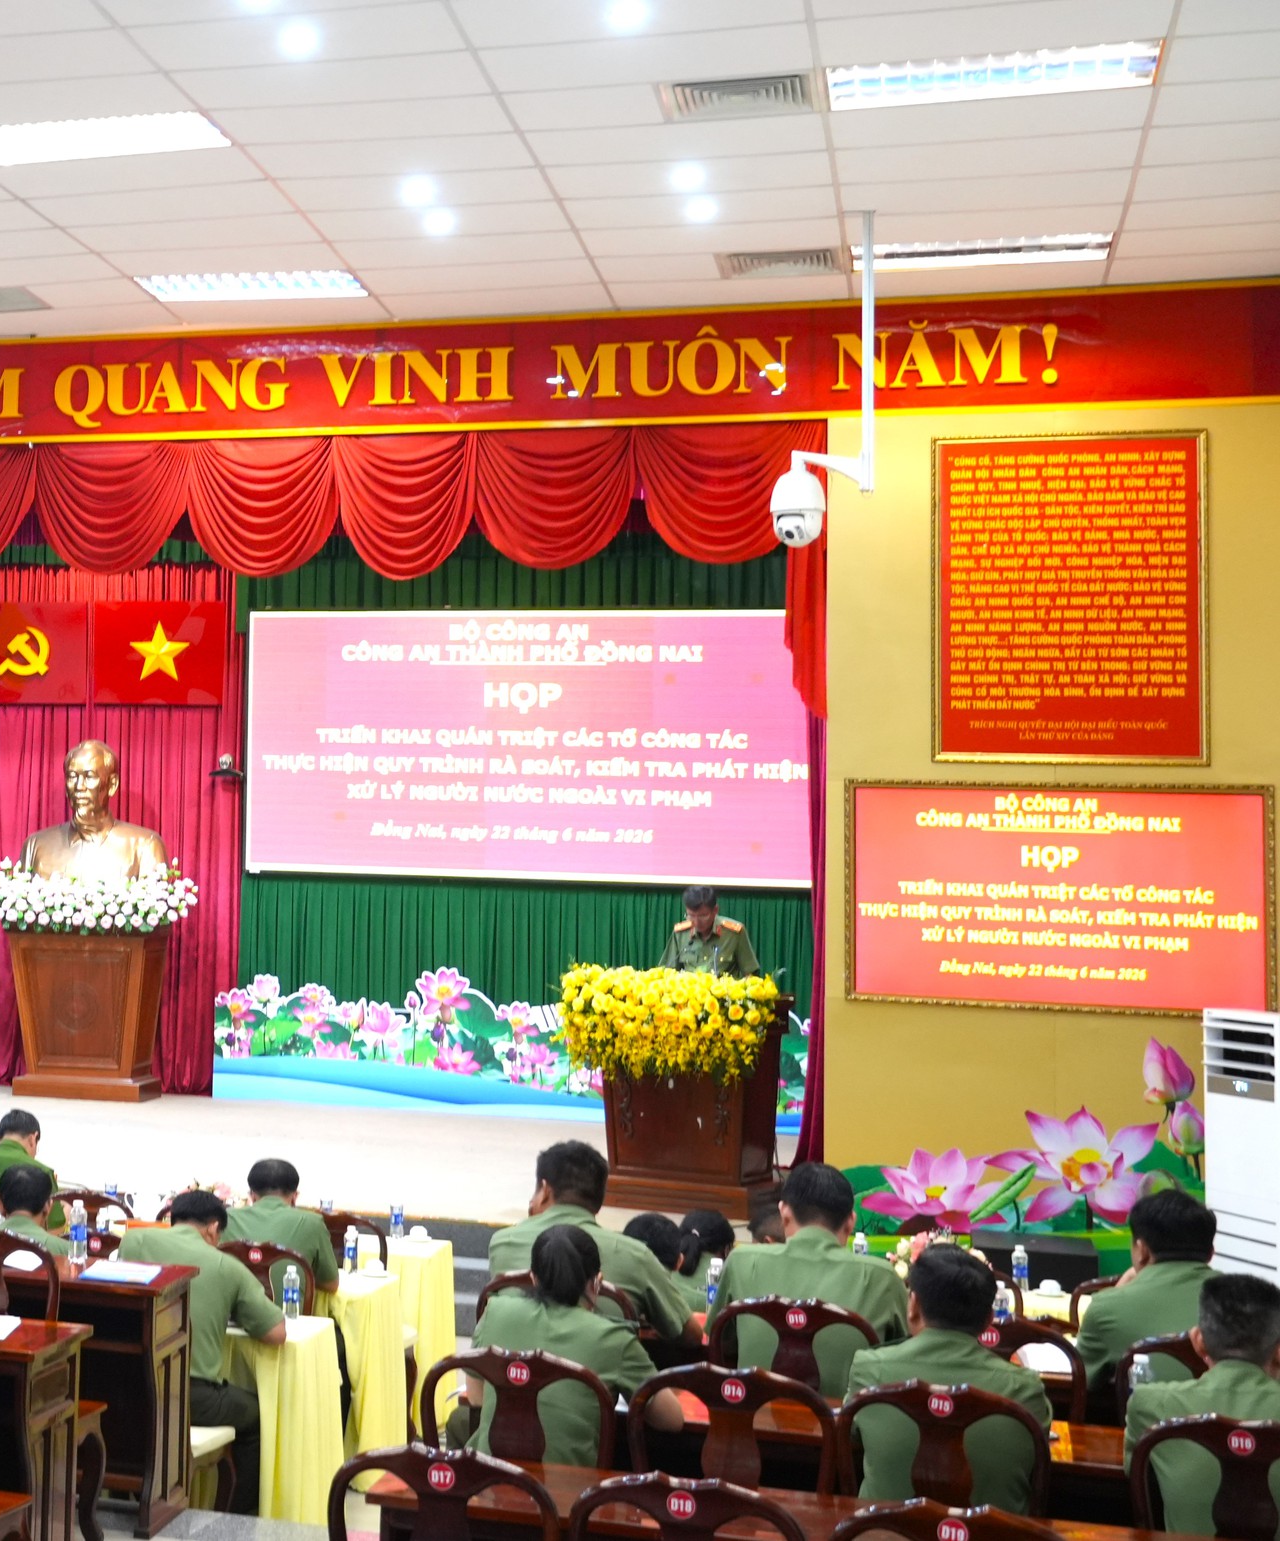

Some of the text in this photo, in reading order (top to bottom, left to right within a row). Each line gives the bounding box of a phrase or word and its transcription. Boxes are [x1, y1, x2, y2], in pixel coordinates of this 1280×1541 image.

[54, 357, 286, 427] QUANG
[316, 346, 513, 405] VINH
[556, 324, 789, 396] MUÔN
[834, 317, 1060, 390] NĂM!
[449, 619, 588, 642] BỘ CÔNG AN
[342, 639, 703, 662] CÔNG AN THÀNH PHỐ ĐỒNG NAI
[484, 682, 562, 714] HỌP
[316, 725, 748, 749] TRIỂN KHAI QUÁN TRIỆT CÁC TỔ CÔNG TÁC
[262, 752, 808, 782] THỰC HIỆN QUY TRÌNH RÀ SOÁT, KIỂM TRA PHÁT HIỆN
[347, 779, 712, 810] XỬ LÝ NGƯỜI NƯỚC NGOÀI VI PHẠM
[994, 793, 1097, 812] BỘ CÔNG AN
[916, 808, 1181, 832] CÔNG AN THÀNH PHỐ ĐỒNG NAI
[1021, 845, 1080, 873] HỌP
[898, 879, 1214, 904] TRIỂN KHAI QUÁN TRIỆT CÁC TỔ CÔNG TÁC
[858, 901, 1258, 932] THỰC HIỆN QUY TRÌNH RÀ SOÁT, KIỂM TRA PHÁT HIỆN
[922, 925, 1189, 953] XỬ LÝ NGƯỜI NƯỚC NGOÀI VI PHẠM
[510, 1367, 527, 1379] D13
[724, 1384, 742, 1397] D14
[931, 1398, 950, 1412] D15
[1231, 1437, 1251, 1450] D16
[431, 1470, 451, 1484] D17
[670, 1498, 691, 1512] D18
